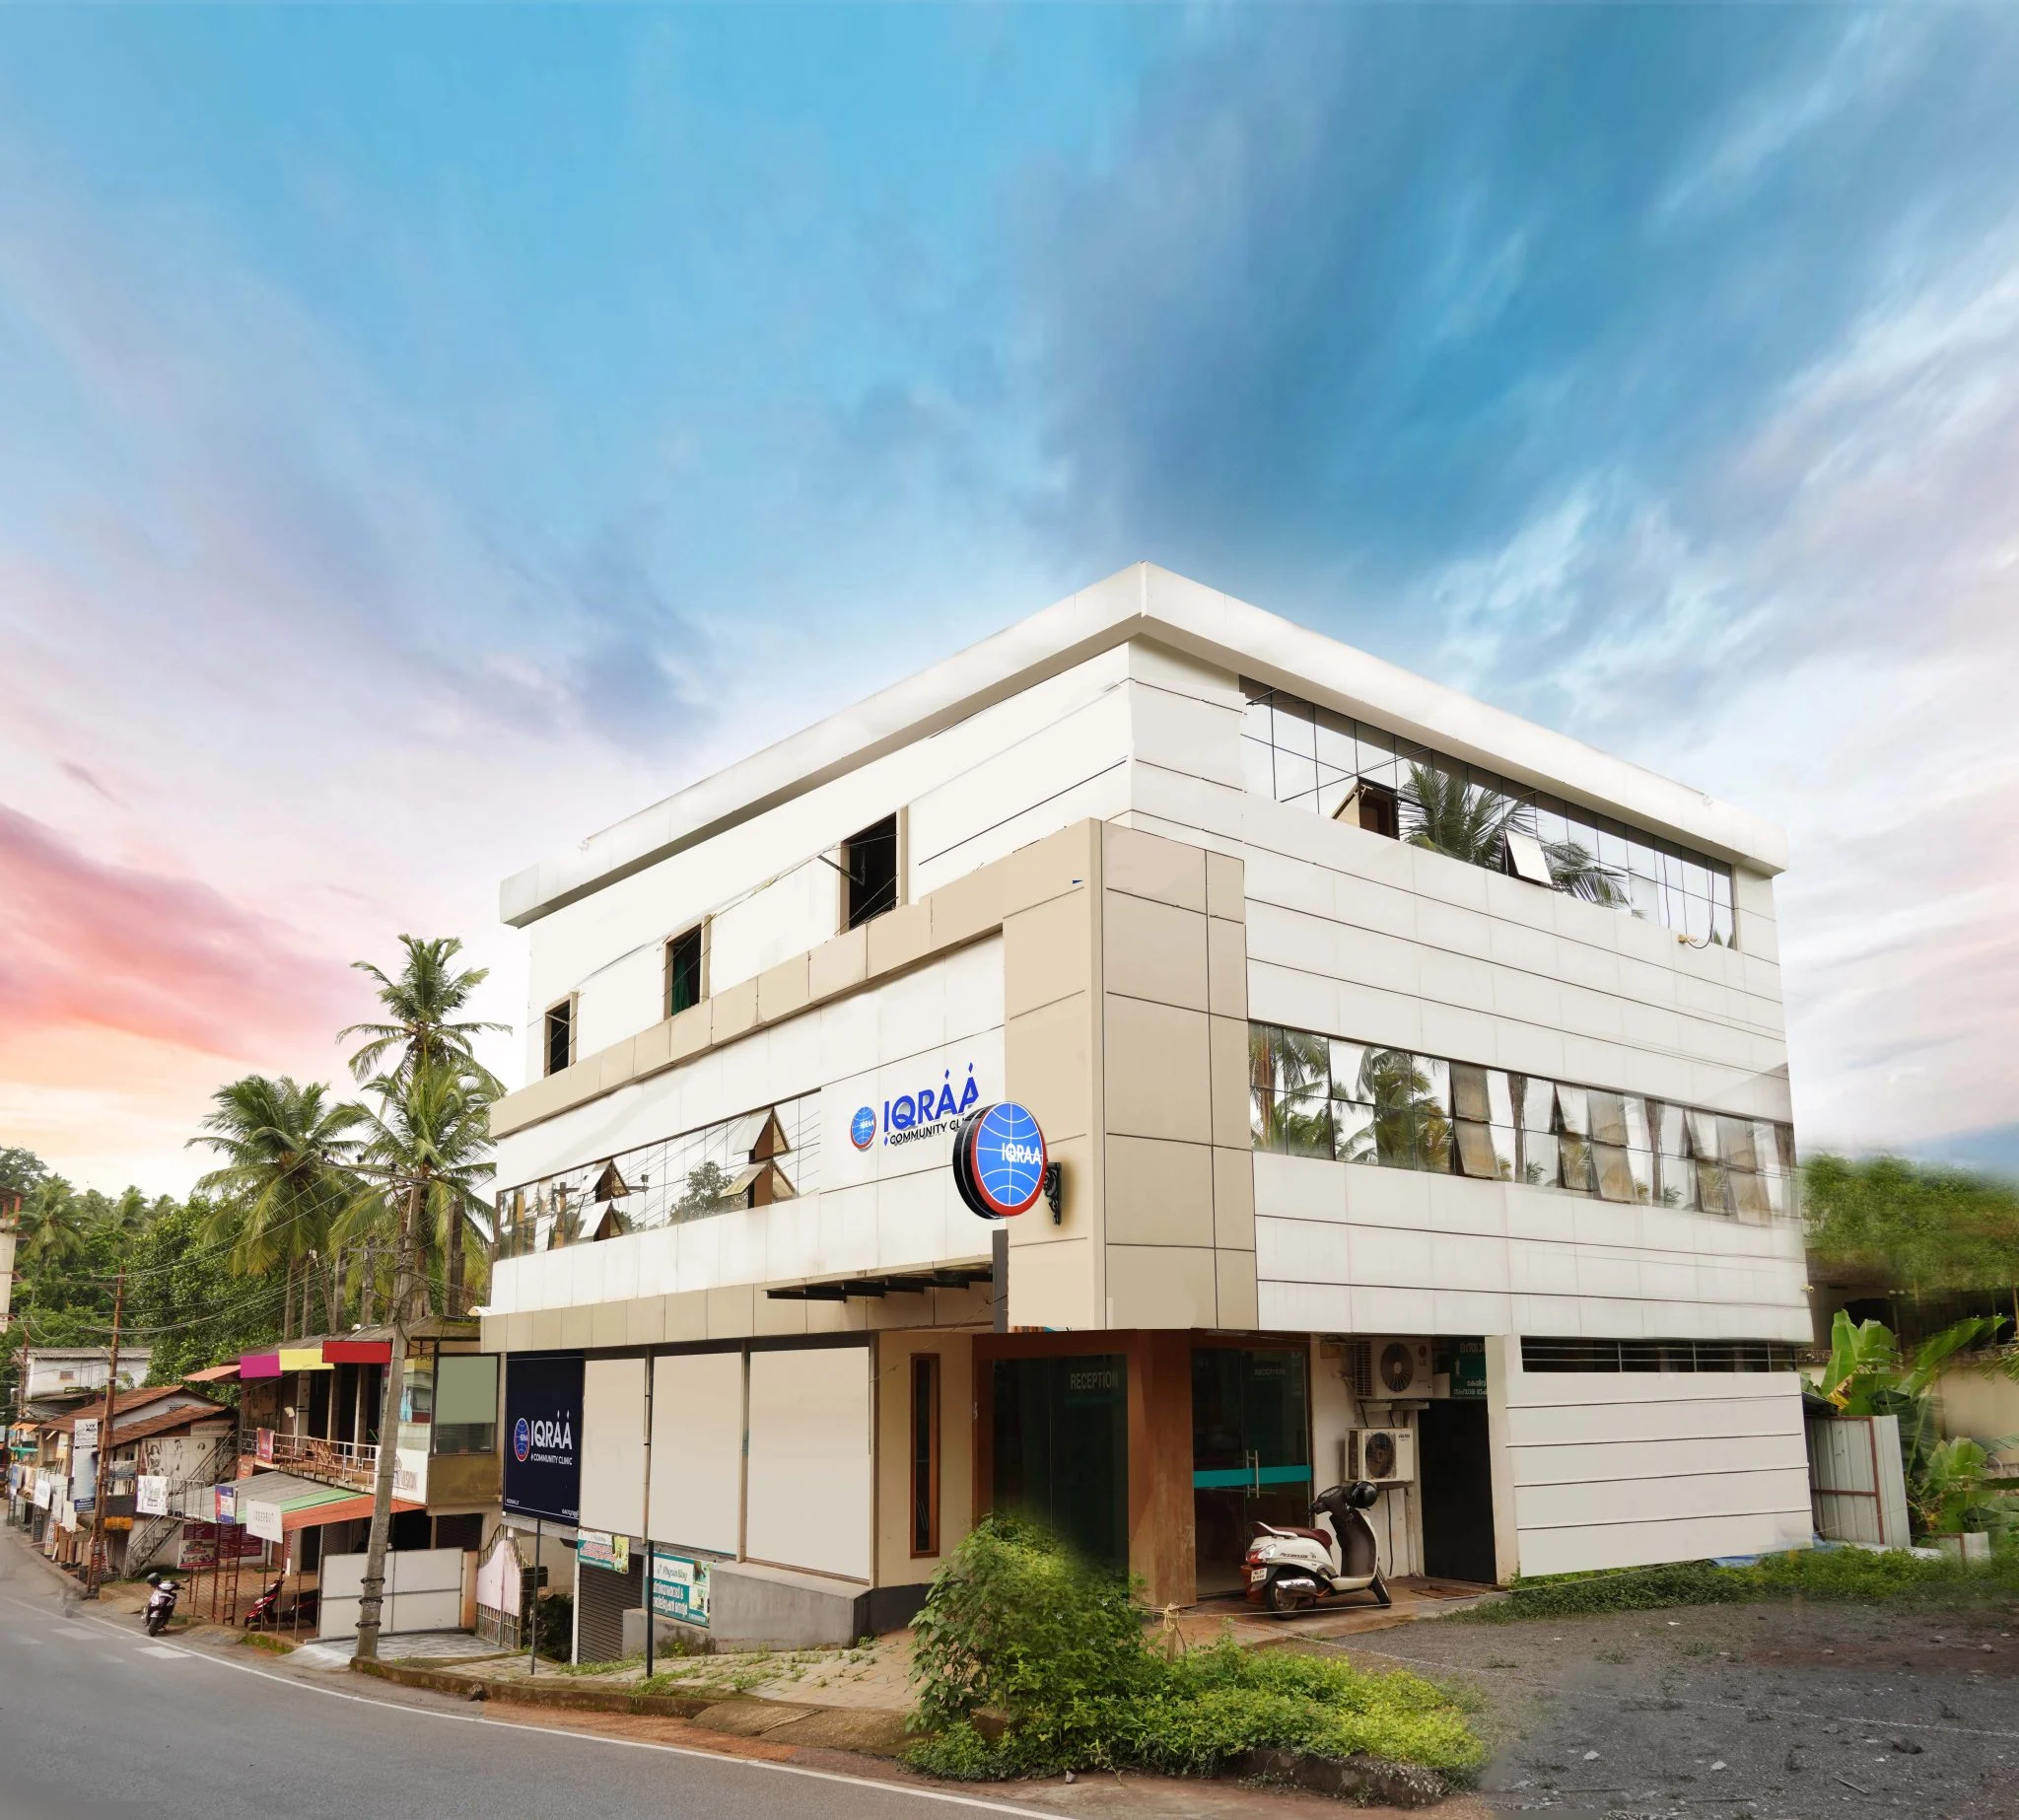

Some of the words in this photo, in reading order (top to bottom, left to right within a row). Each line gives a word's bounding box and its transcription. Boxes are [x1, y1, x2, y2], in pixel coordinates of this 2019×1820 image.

[890, 1122, 947, 1145] COMMUNITY
[1002, 1142, 1042, 1165] IQRAA
[1071, 1370, 1119, 1390] RECEPTION
[533, 1453, 559, 1465] COMMUNITY
[558, 1455, 573, 1466] CLINIC
